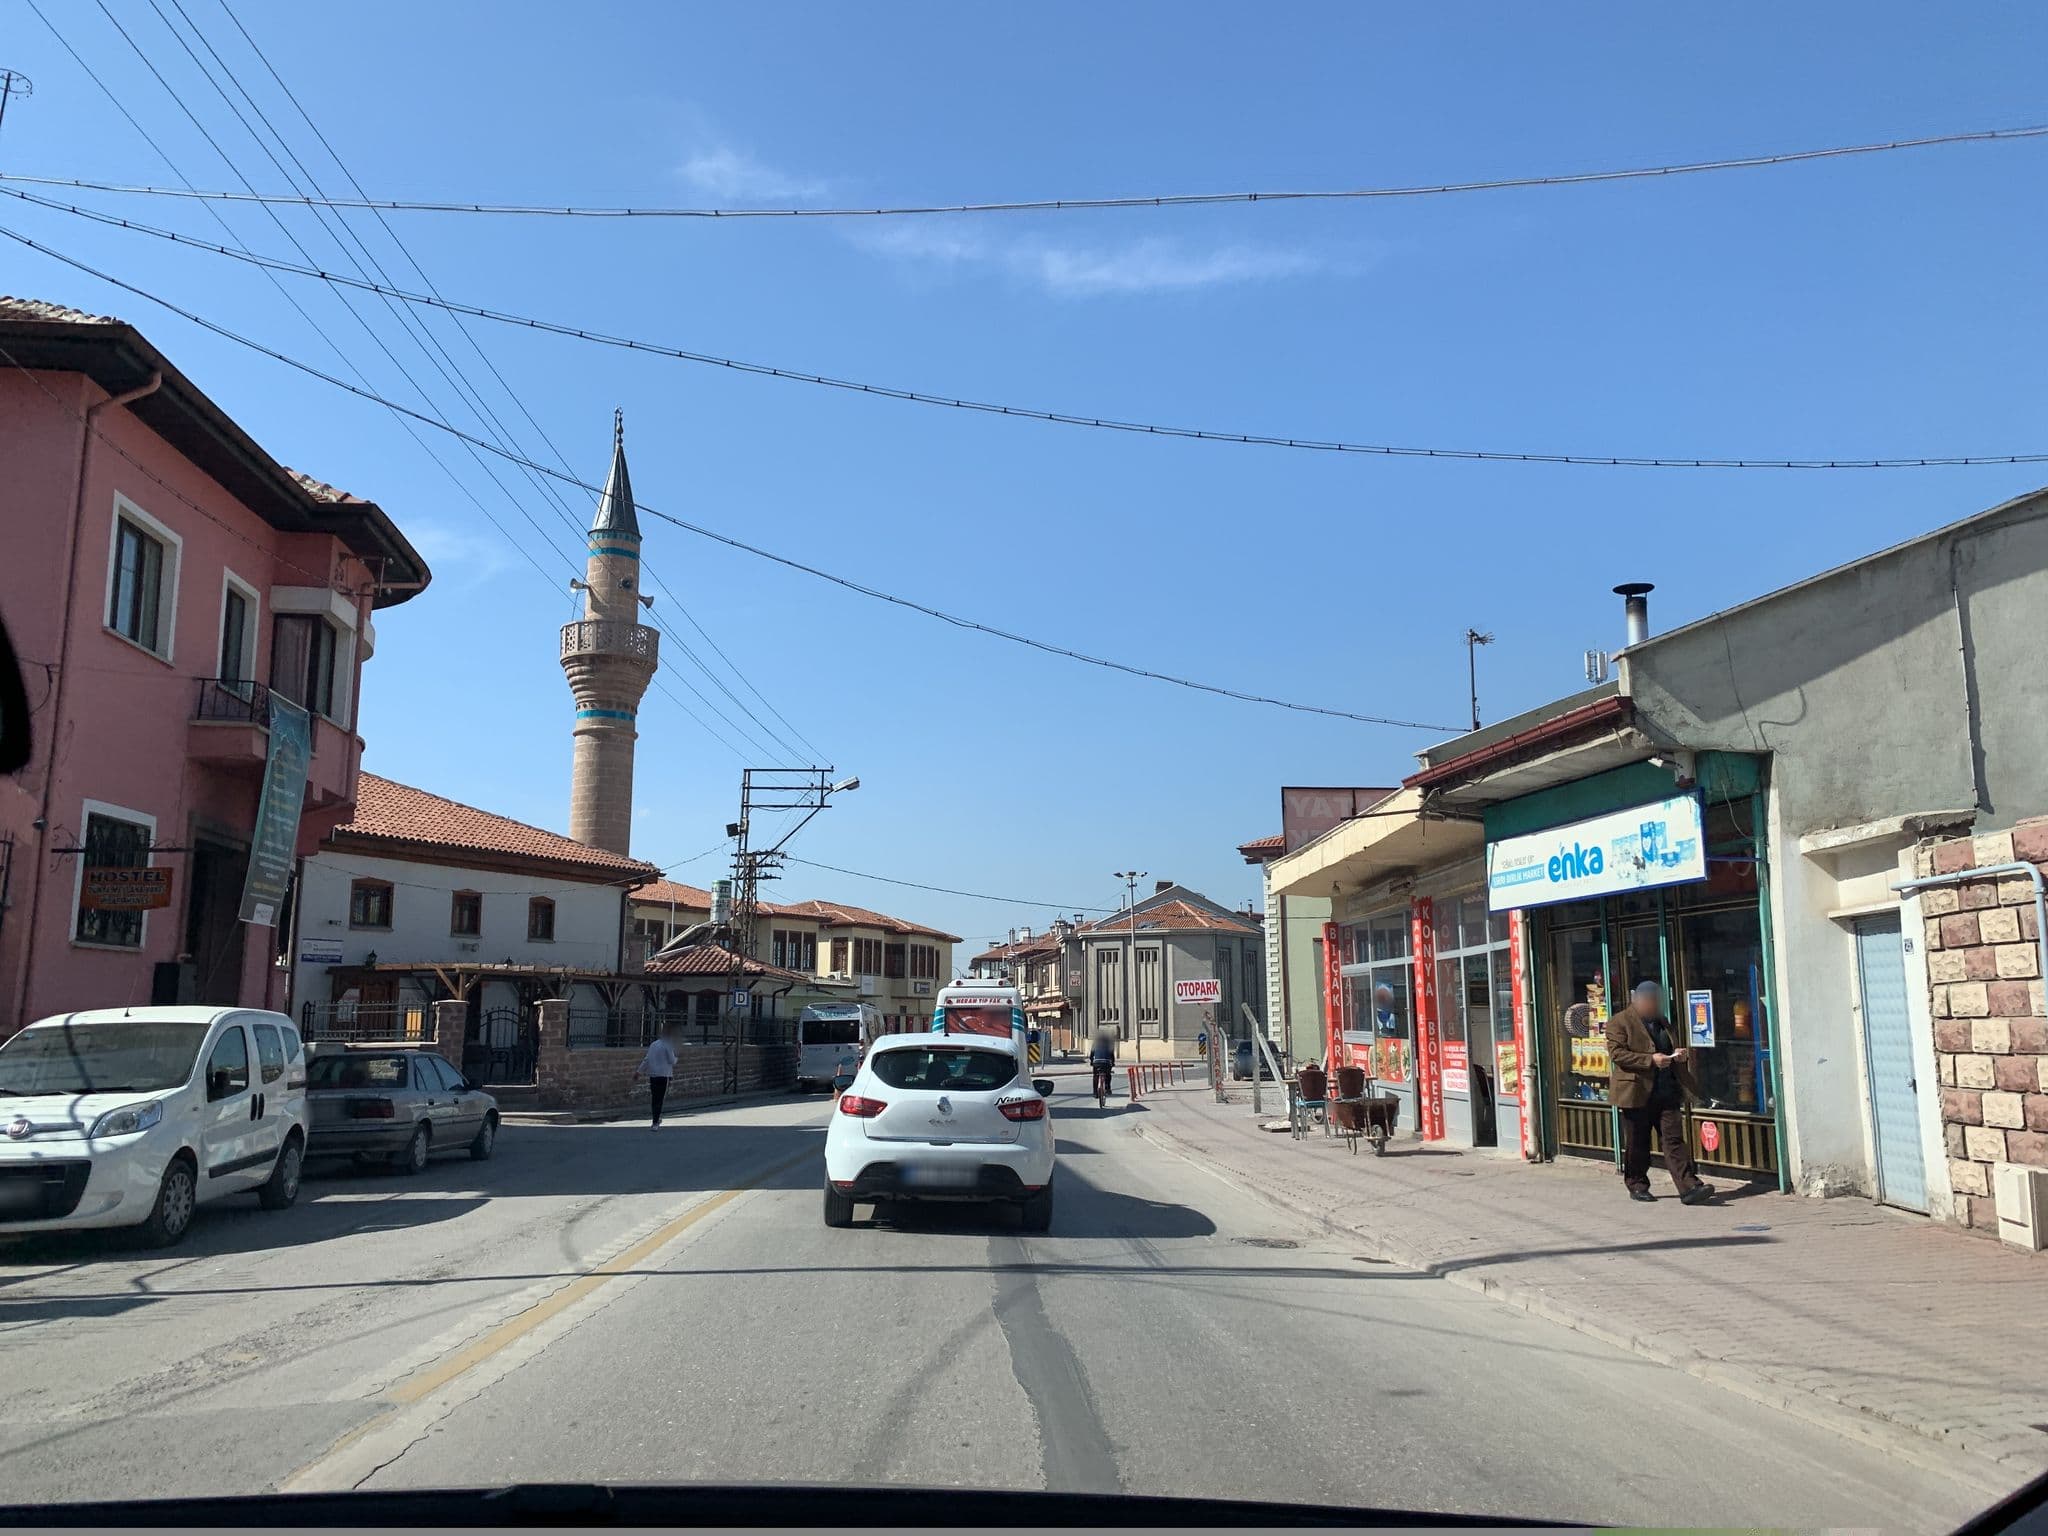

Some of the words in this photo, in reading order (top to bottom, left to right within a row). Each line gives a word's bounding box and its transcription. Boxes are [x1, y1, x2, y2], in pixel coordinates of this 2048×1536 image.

[1549, 841, 1604, 882] enka
[90, 871, 166, 882] HOSTEL
[1328, 927, 1341, 1007] BIÇAK
[737, 993, 746, 1004] D
[1177, 981, 1219, 996] OTOPARK
[1421, 905, 1434, 997] KONYA
[1428, 1020, 1441, 1136] BÖREĞİ
